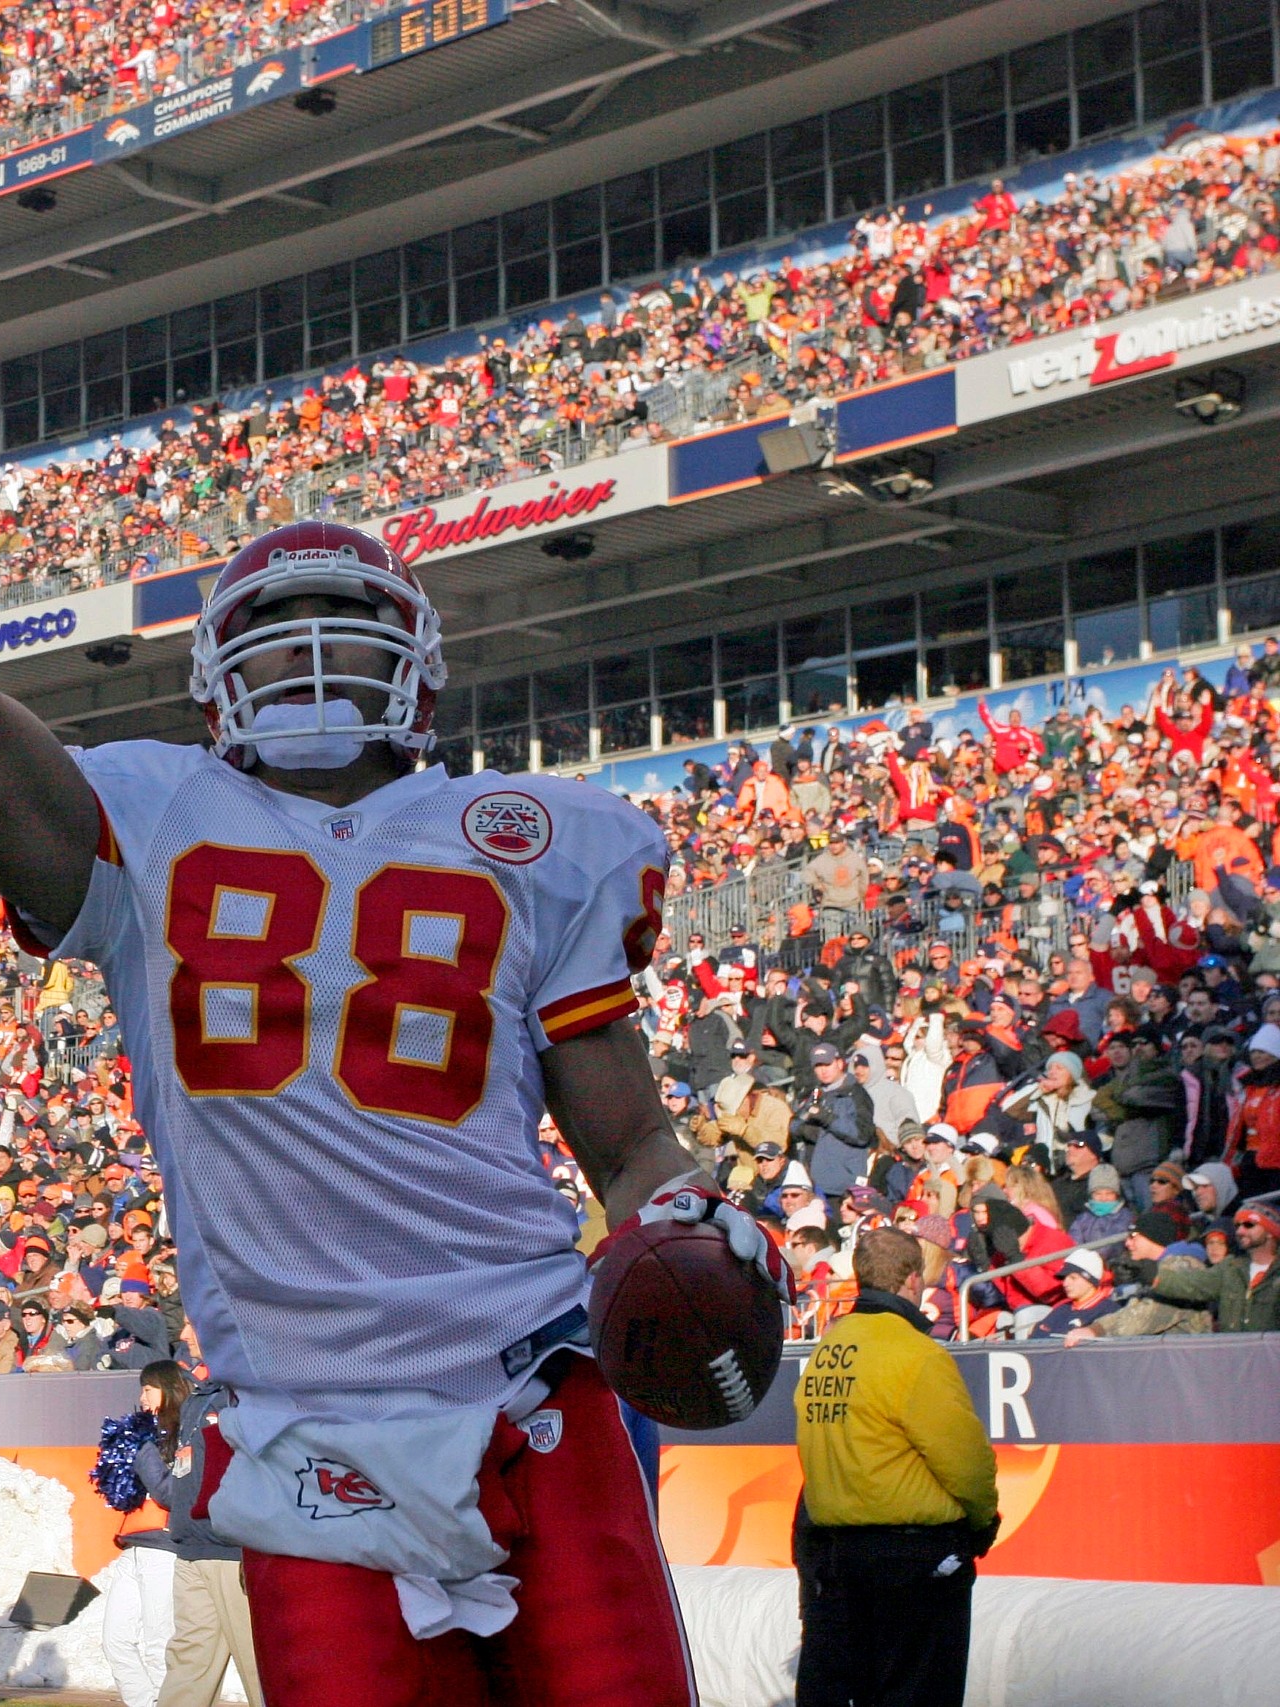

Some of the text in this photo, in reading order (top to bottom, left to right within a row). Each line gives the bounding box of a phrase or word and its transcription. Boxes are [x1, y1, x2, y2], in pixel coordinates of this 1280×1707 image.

[154, 77, 233, 115] CHAMPIONS
[154, 97, 234, 136] COMMUNITY
[1008, 316, 1179, 396] verizon
[382, 479, 617, 564] Budweiser
[166, 842, 511, 1128] 88
[815, 1344, 858, 1369] CSC
[804, 1376, 856, 1398] EVENT
[988, 1352, 1037, 1440] R
[805, 1403, 849, 1424] STAFF
